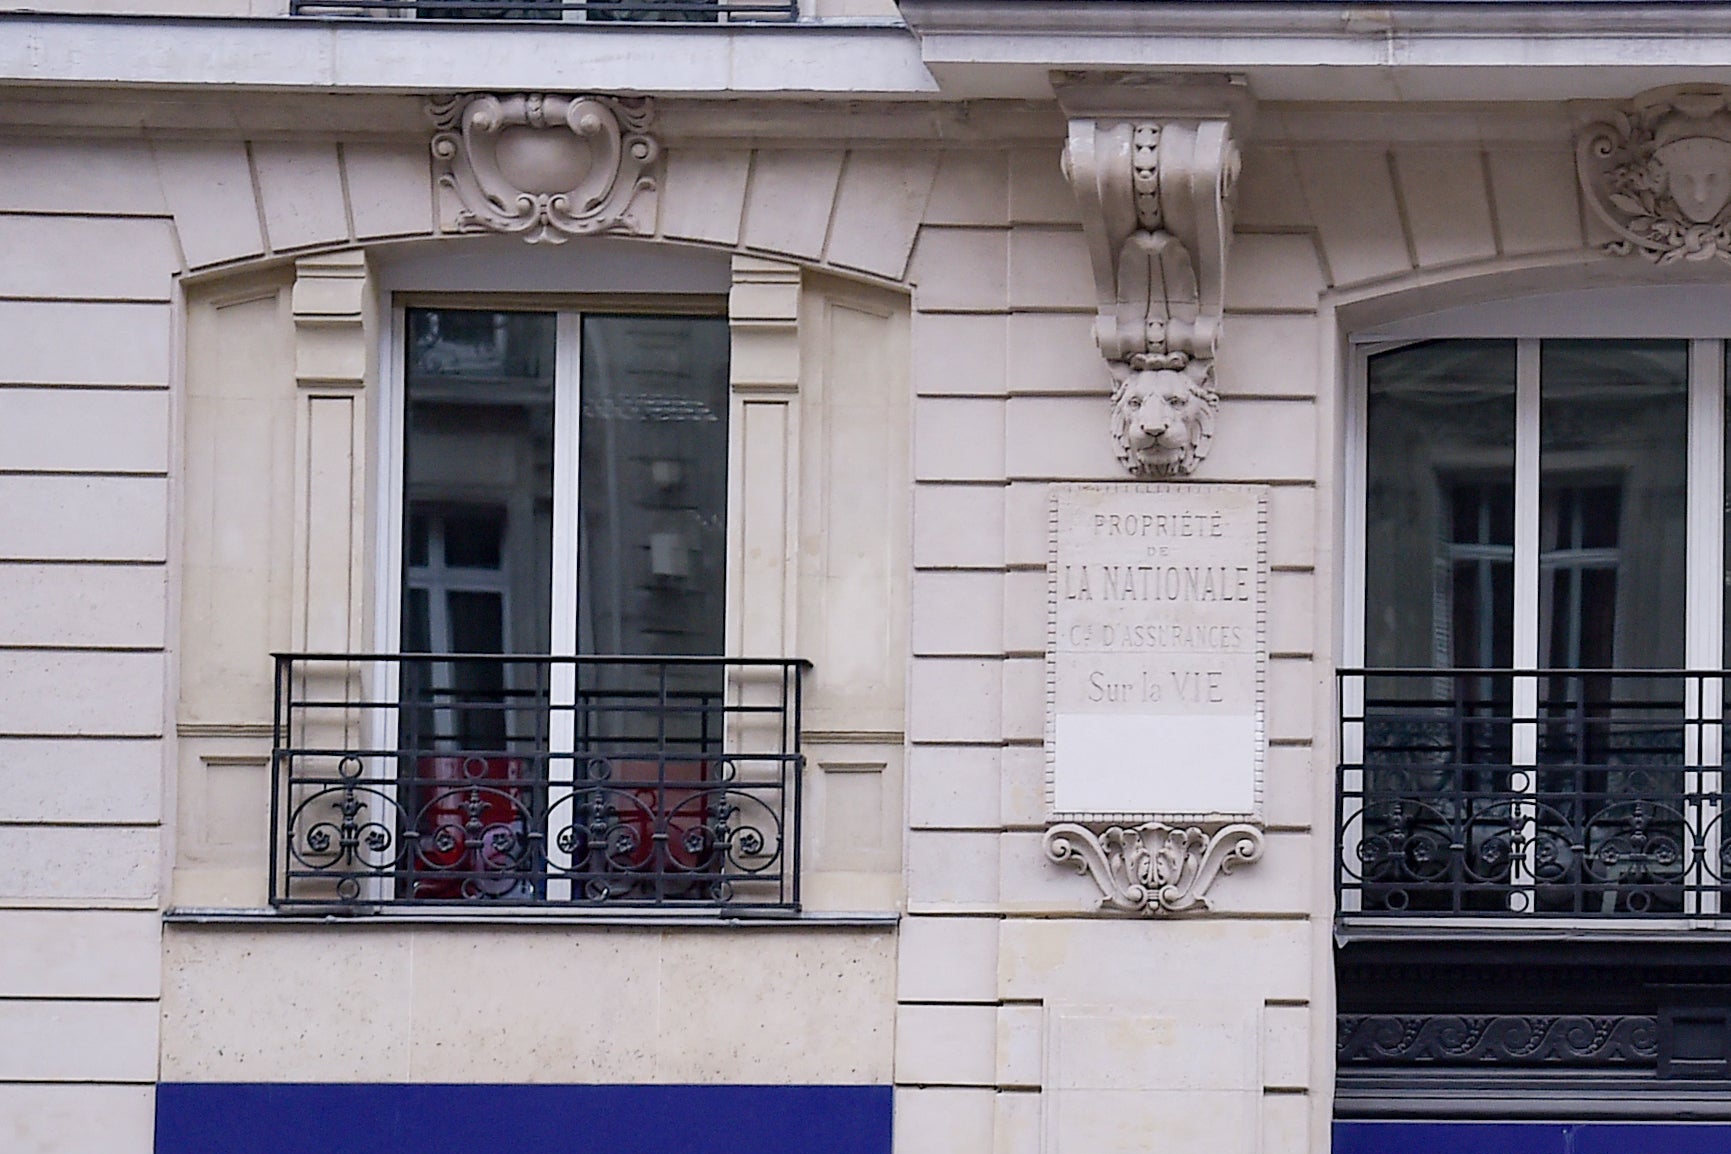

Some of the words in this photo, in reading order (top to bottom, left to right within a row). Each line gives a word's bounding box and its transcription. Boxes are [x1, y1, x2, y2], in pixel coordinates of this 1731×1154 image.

[1146, 546, 1169, 557] DE
[1065, 565, 1093, 601] LA
[1103, 565, 1249, 602] NATIONALE
[1103, 624, 1242, 648] D'ASSURANCES
[1088, 671, 1132, 703] Sur
[1142, 671, 1162, 703] la
[1171, 671, 1224, 703] VIE
